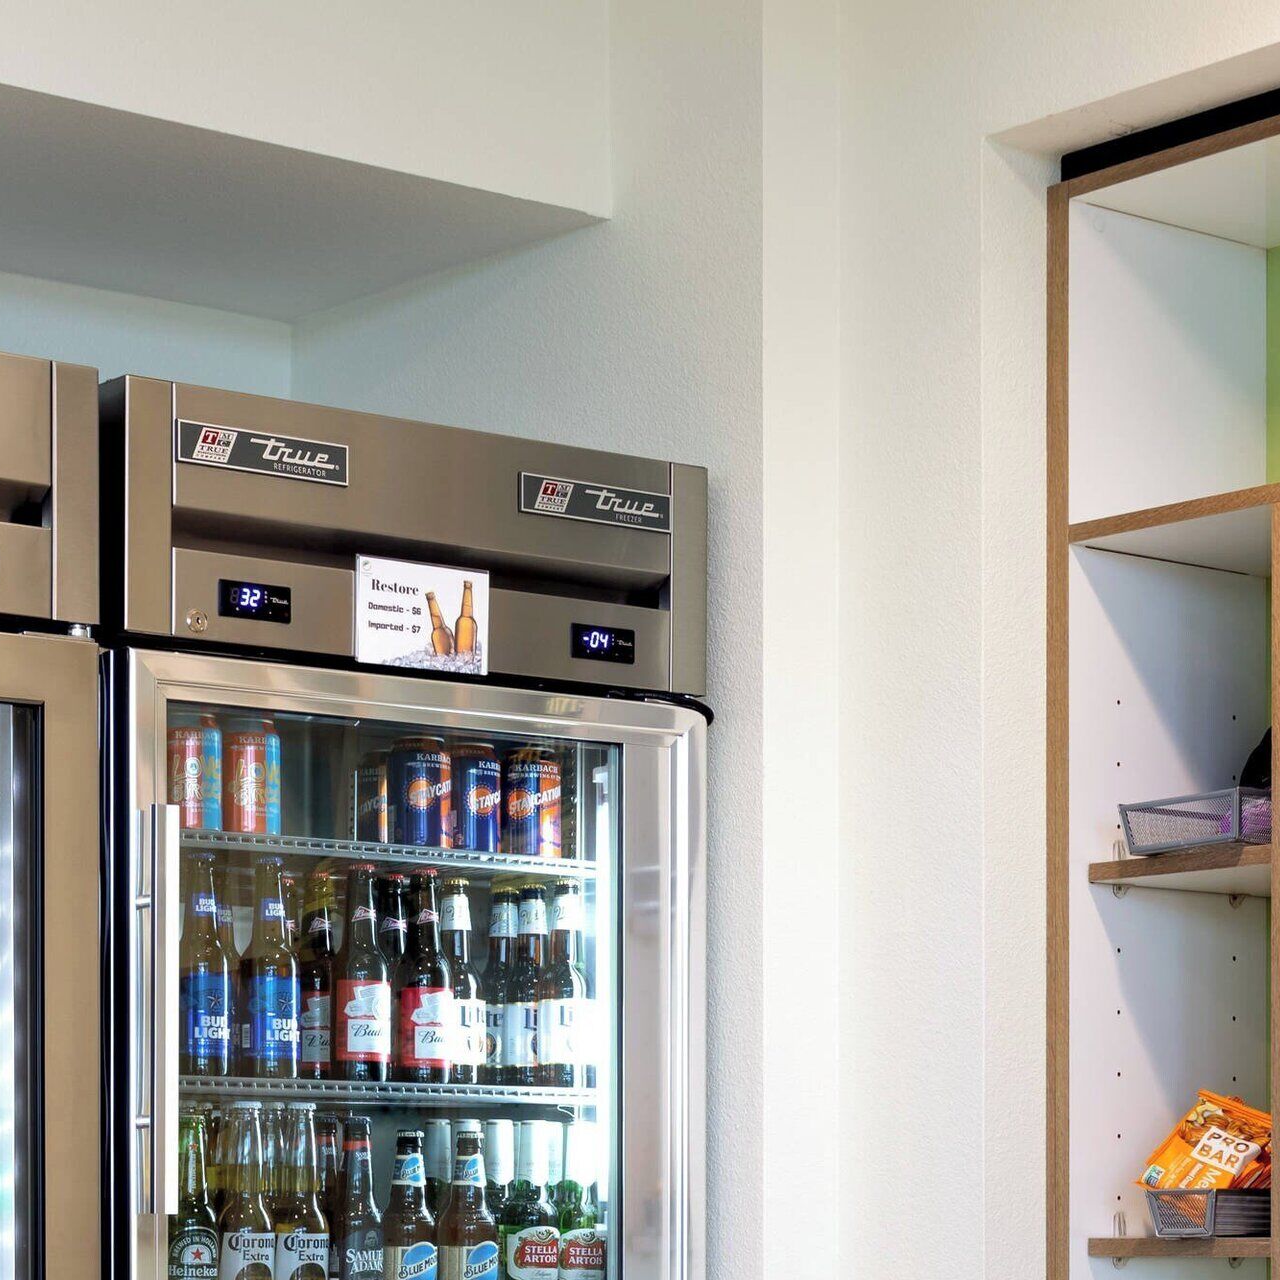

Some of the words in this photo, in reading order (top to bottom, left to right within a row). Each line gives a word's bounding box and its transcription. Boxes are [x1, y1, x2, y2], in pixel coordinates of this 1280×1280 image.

[273, 462, 326, 477] REFRIGERATOR
[615, 513, 642, 523] FREEZER
[371, 579, 419, 596] Restore
[240, 588, 261, 607] 32
[368, 602, 404, 613] Domestic
[412, 606, 422, 615] $6
[368, 620, 404, 632] Imported
[412, 625, 421, 634] $7
[516, 763, 558, 774] KARBACH
[200, 1015, 228, 1027] BUD
[272, 1018, 298, 1030] BUD
[1206, 1132, 1250, 1154] PRO
[1197, 1143, 1240, 1168] BAR
[524, 1245, 558, 1254] STELLA
[569, 1247, 603, 1256] STELLA
[242, 1251, 270, 1261] Extra
[298, 1251, 324, 1261] Extra
[523, 1254, 558, 1264] ARTOIS
[568, 1256, 604, 1265] ARTOIS
[398, 1261, 424, 1279] BLUE
[463, 1261, 488, 1279] BLUE
